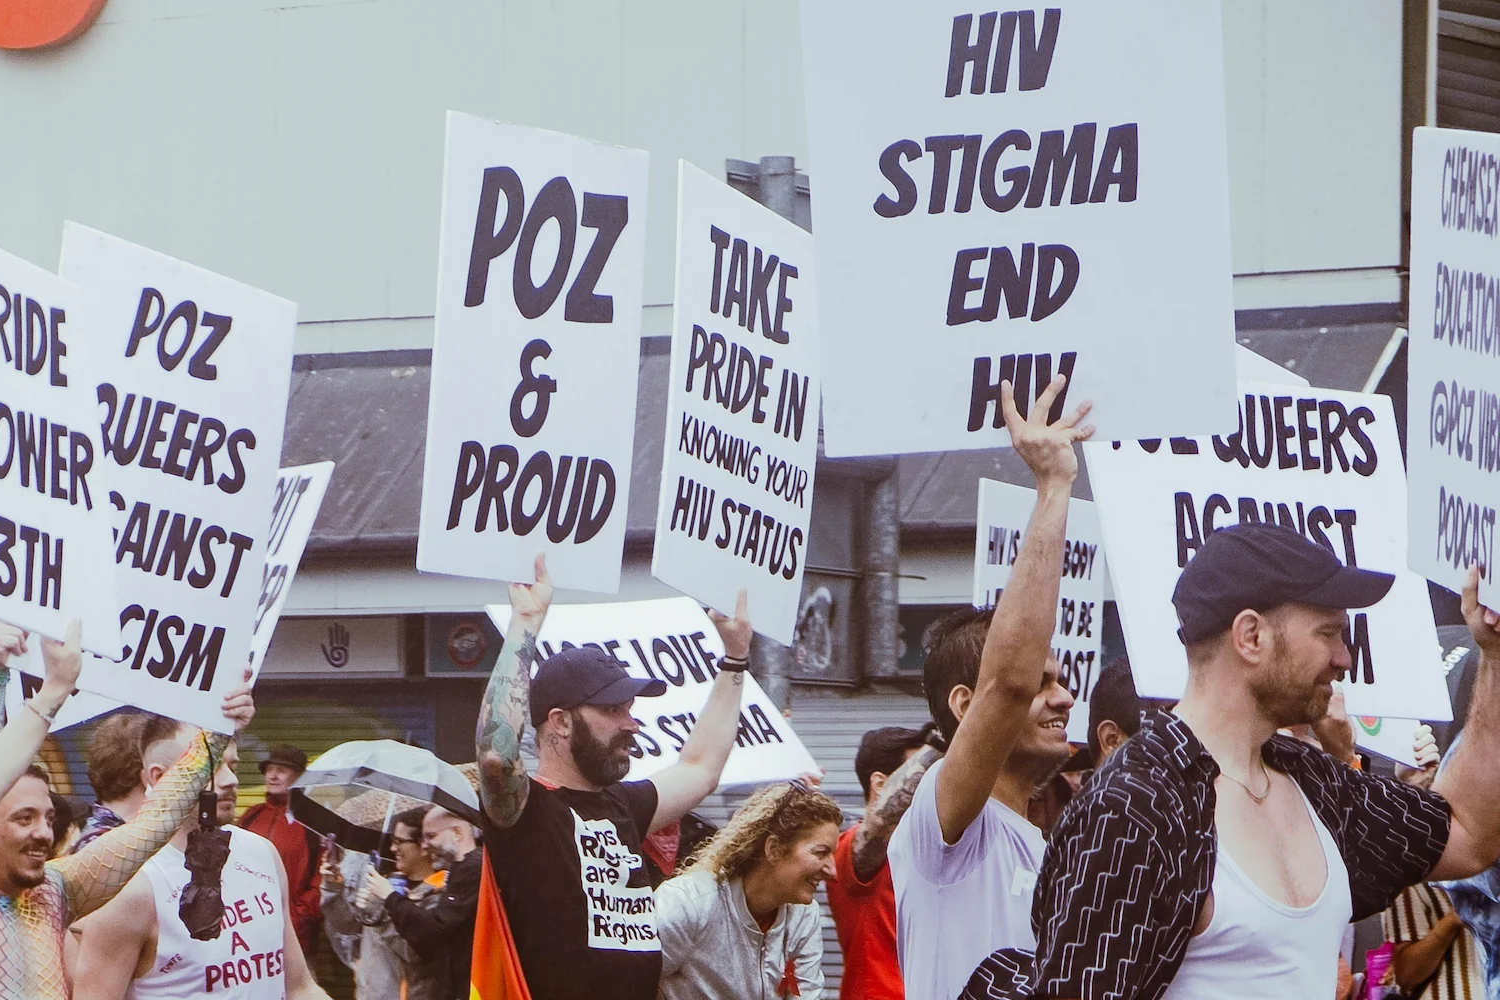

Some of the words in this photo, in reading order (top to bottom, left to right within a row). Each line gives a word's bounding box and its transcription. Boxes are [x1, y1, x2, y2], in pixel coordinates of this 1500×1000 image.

[945, 8, 1061, 98] HIV
[873, 122, 1139, 218] STIGMA
[464, 166, 628, 323] POZ
[709, 224, 798, 344] TAKE
[946, 242, 1080, 326] END
[126, 287, 232, 380] POZ
[510, 339, 557, 438] &
[686, 323, 773, 424] PRIDE
[774, 369, 809, 441] IN
[966, 352, 1077, 432] HIV
[1429, 379, 1475, 462] @POZ
[446, 441, 616, 545] PROUD
[679, 411, 760, 485] KNOWING
[765, 448, 808, 509] YOUR
[670, 476, 715, 541] HIV
[715, 497, 803, 581] STATUS
[987, 525, 1008, 565] HIV
[1437, 485, 1495, 585] PODCAST
[117, 604, 226, 692] CISM
[1060, 597, 1075, 637] TO
[1077, 601, 1094, 638] BE
[1057, 647, 1096, 702] OST
[254, 892, 274, 915] IS
[585, 866, 620, 885] are
[588, 887, 652, 915] Human
[231, 931, 250, 955] A
